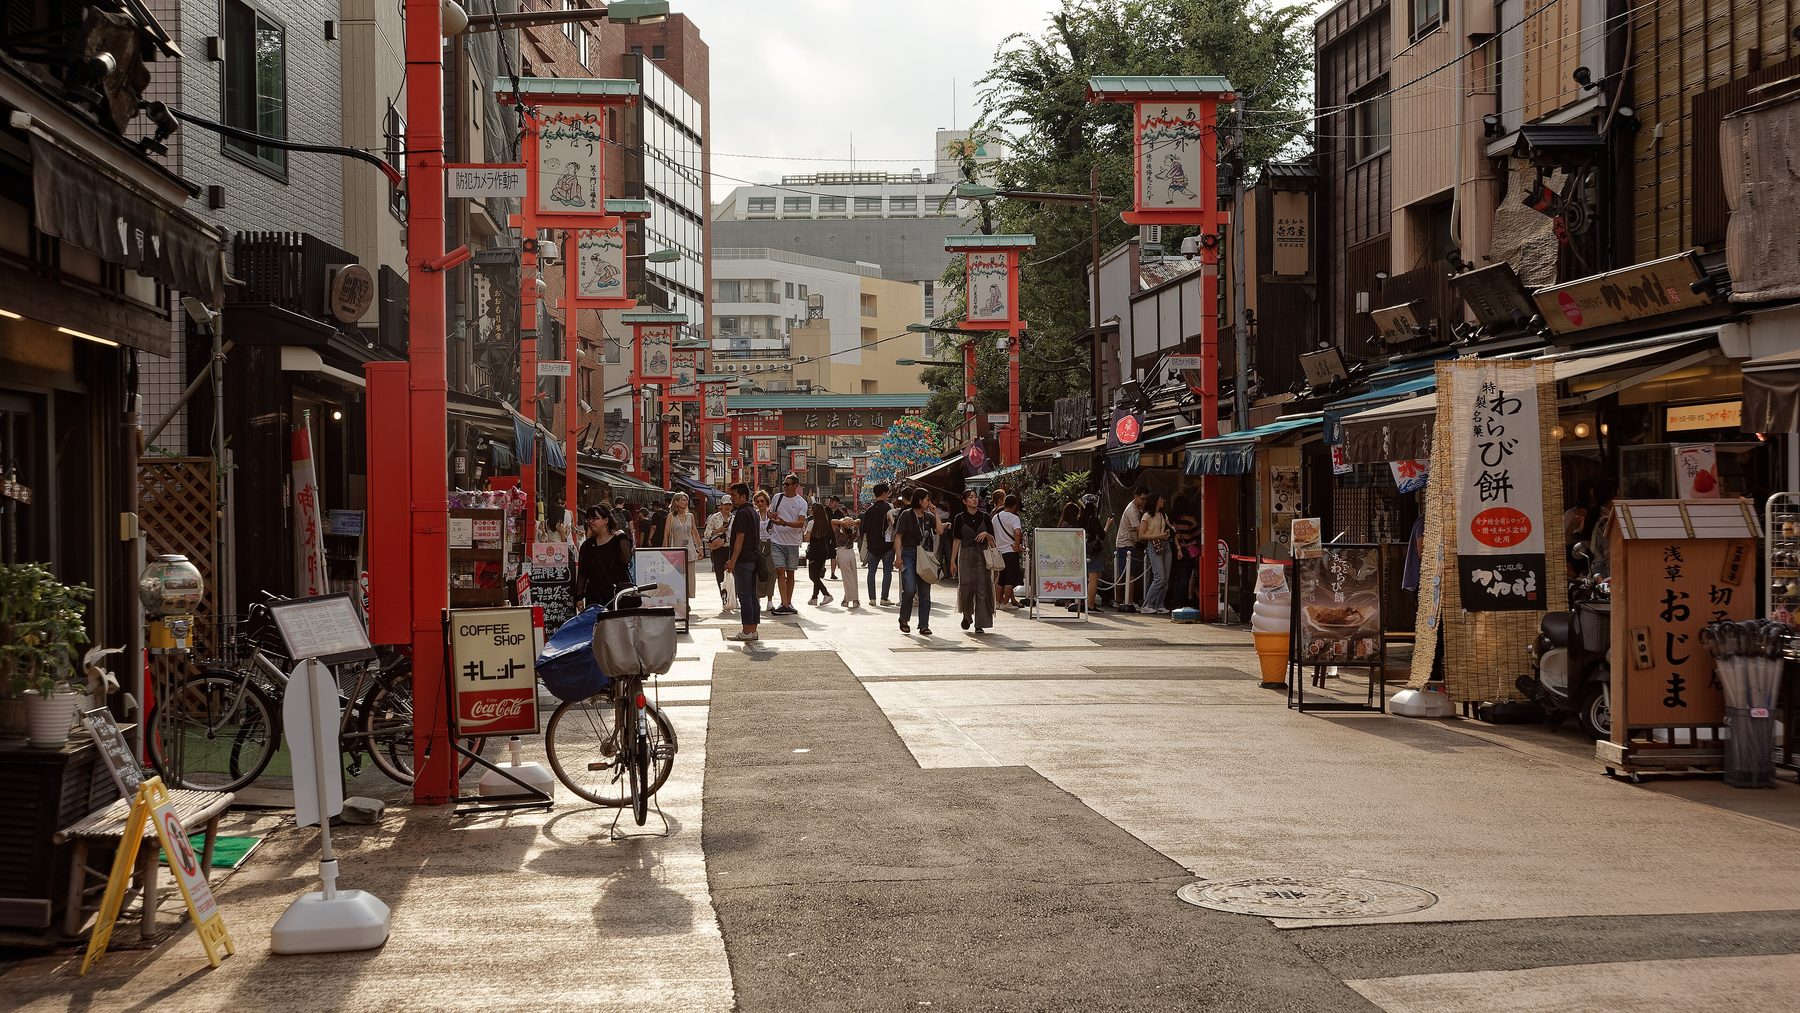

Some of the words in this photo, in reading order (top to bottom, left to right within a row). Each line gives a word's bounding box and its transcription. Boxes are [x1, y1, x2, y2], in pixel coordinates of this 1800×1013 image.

[456, 171, 519, 190] 防犯カメラ作動中
[669, 402, 681, 443] 大黒家
[1472, 381, 1496, 437] 特製名菓
[1473, 390, 1522, 503] わらび餅
[532, 567, 567, 580] 無限堂
[1331, 563, 1346, 603] わらび餅
[460, 624, 510, 637] COFFEE
[493, 634, 526, 646] SHOP
